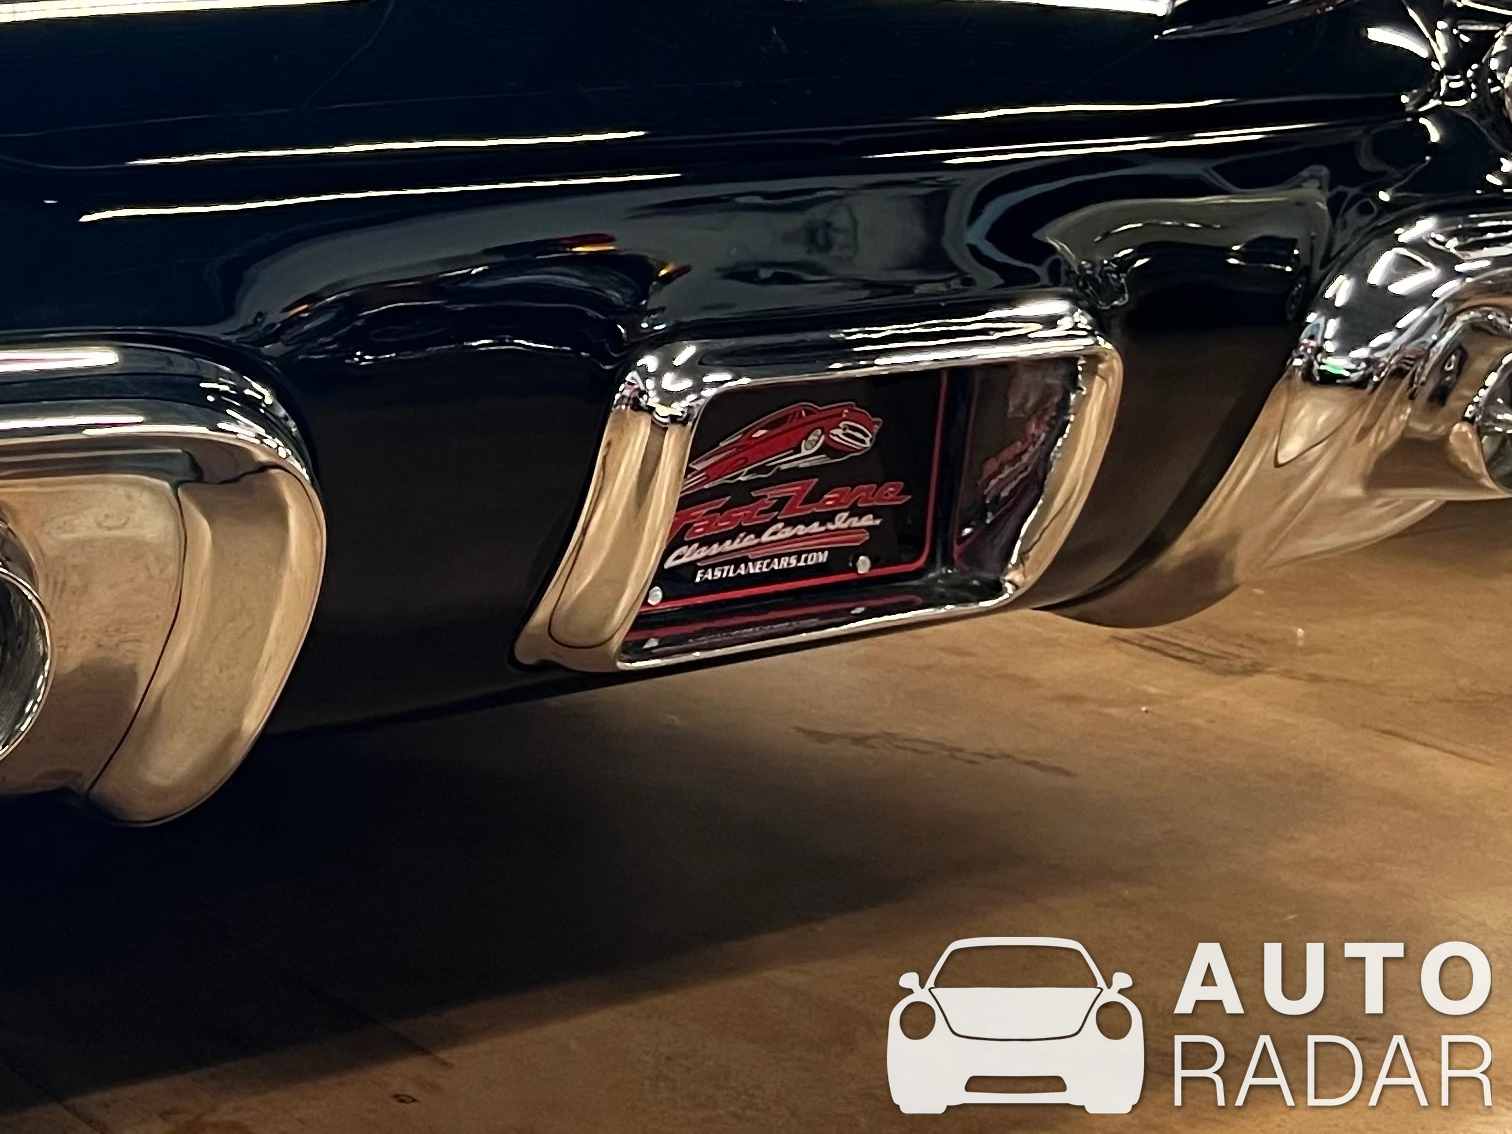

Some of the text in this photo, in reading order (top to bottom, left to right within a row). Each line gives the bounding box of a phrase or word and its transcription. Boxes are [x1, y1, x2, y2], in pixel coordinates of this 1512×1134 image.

[665, 478, 912, 545] Fast Lane
[664, 512, 884, 569] Classic Cars Inc.
[694, 550, 829, 583] FASTLANECARS.COM
